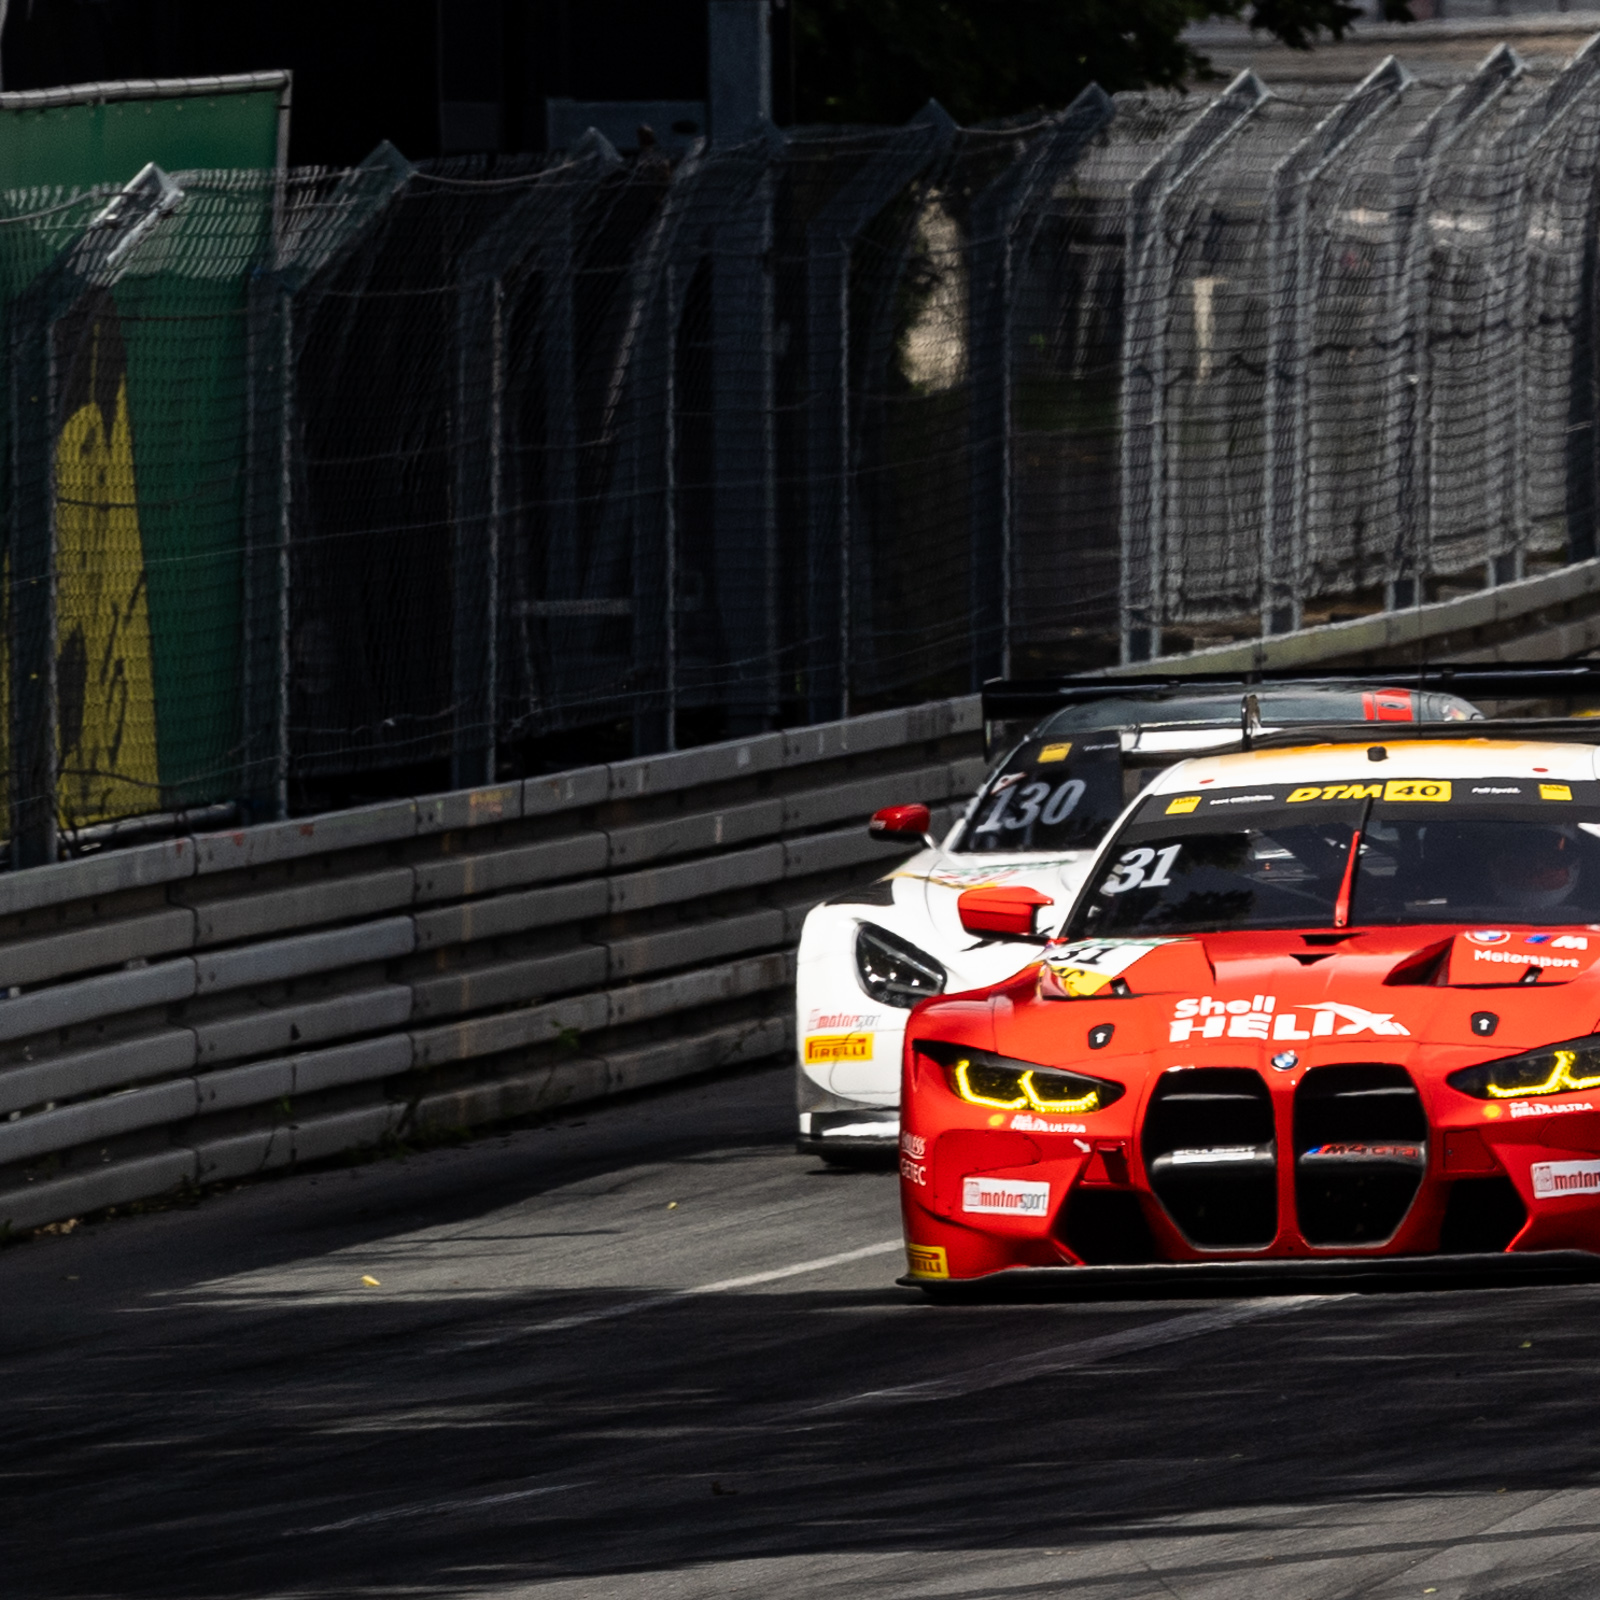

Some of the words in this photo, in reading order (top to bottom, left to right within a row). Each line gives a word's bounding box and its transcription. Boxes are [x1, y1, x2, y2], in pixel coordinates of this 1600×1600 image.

[1286, 784, 1384, 803] DTM
[1395, 784, 1440, 798] 40
[976, 778, 1087, 834] 130
[1100, 843, 1182, 894] 31
[1474, 949, 1580, 968] Motorsport
[1175, 994, 1277, 1018] Shell
[1169, 1001, 1411, 1042] HELIX
[807, 1037, 867, 1060] PIRELLI
[1551, 1102, 1594, 1113] ULTRA
[980, 1189, 1047, 1212] motorsport
